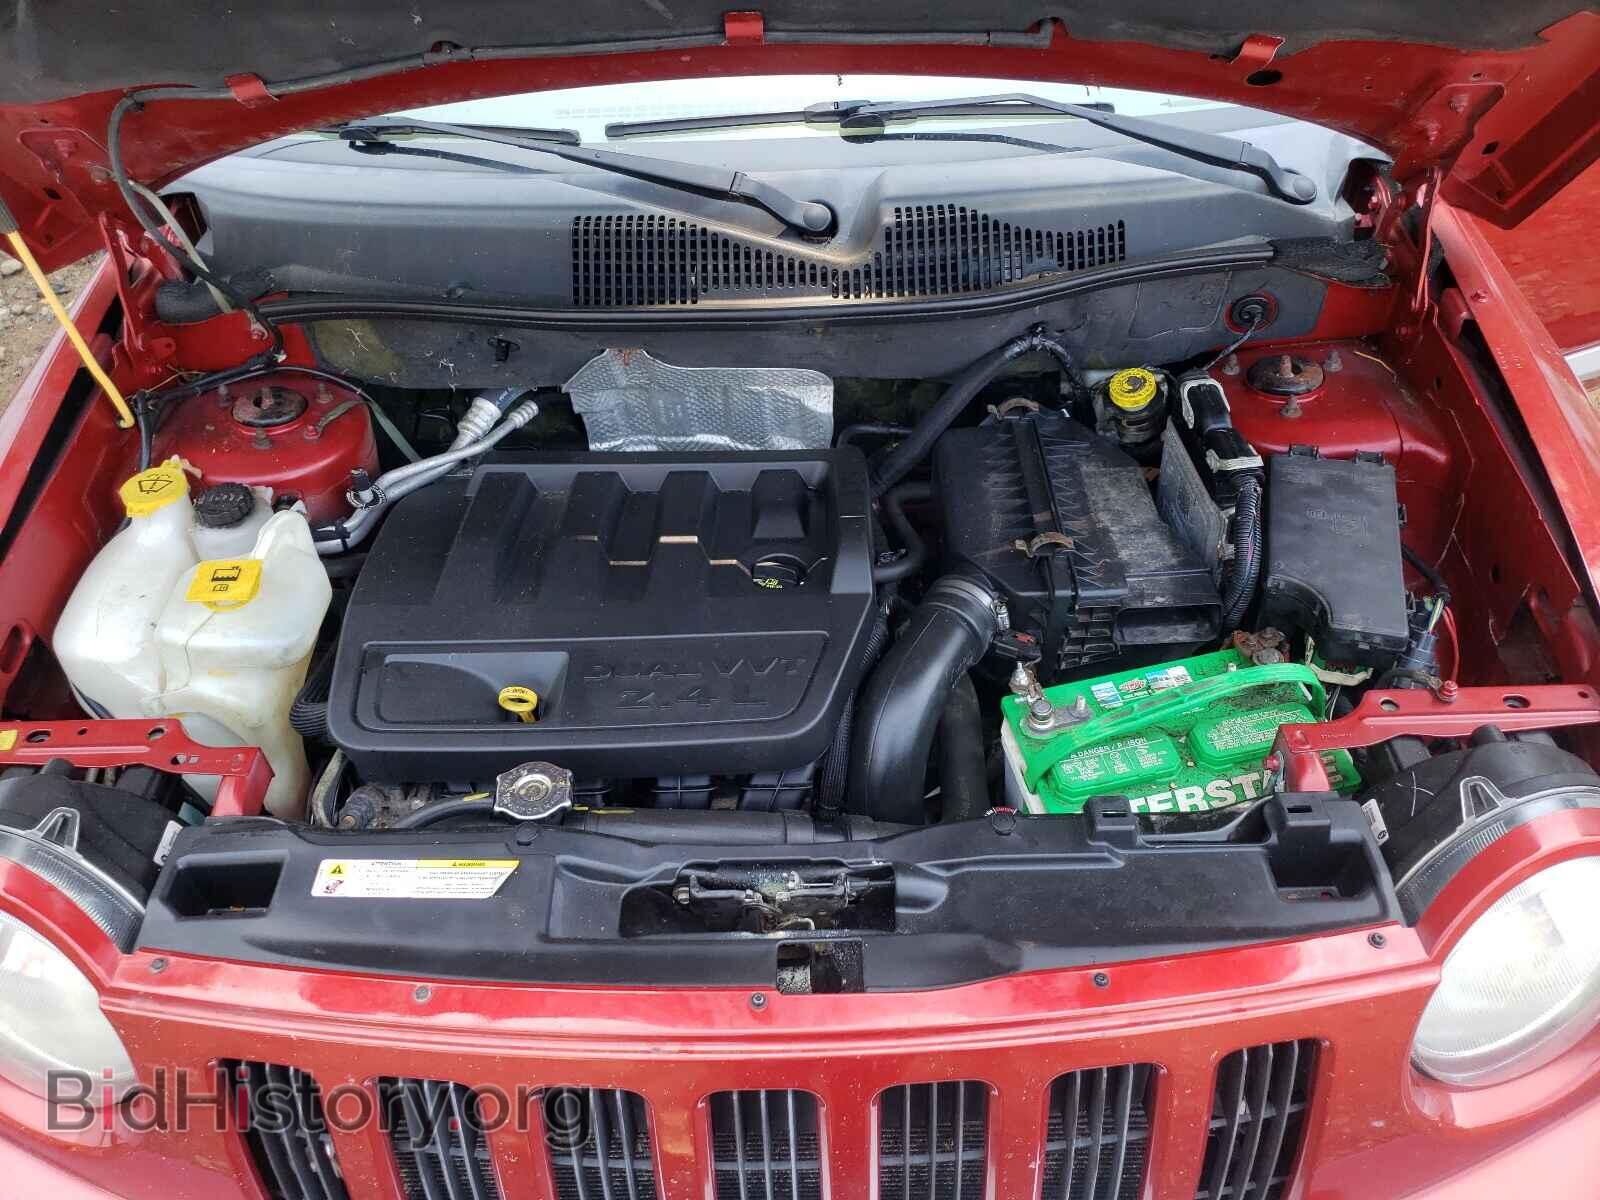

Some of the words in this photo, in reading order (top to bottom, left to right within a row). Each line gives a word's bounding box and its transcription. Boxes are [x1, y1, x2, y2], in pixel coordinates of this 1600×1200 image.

[711, 656, 808, 677] VVT
[1078, 744, 1110, 758] DANGER
[1117, 737, 1147, 750] PISON
